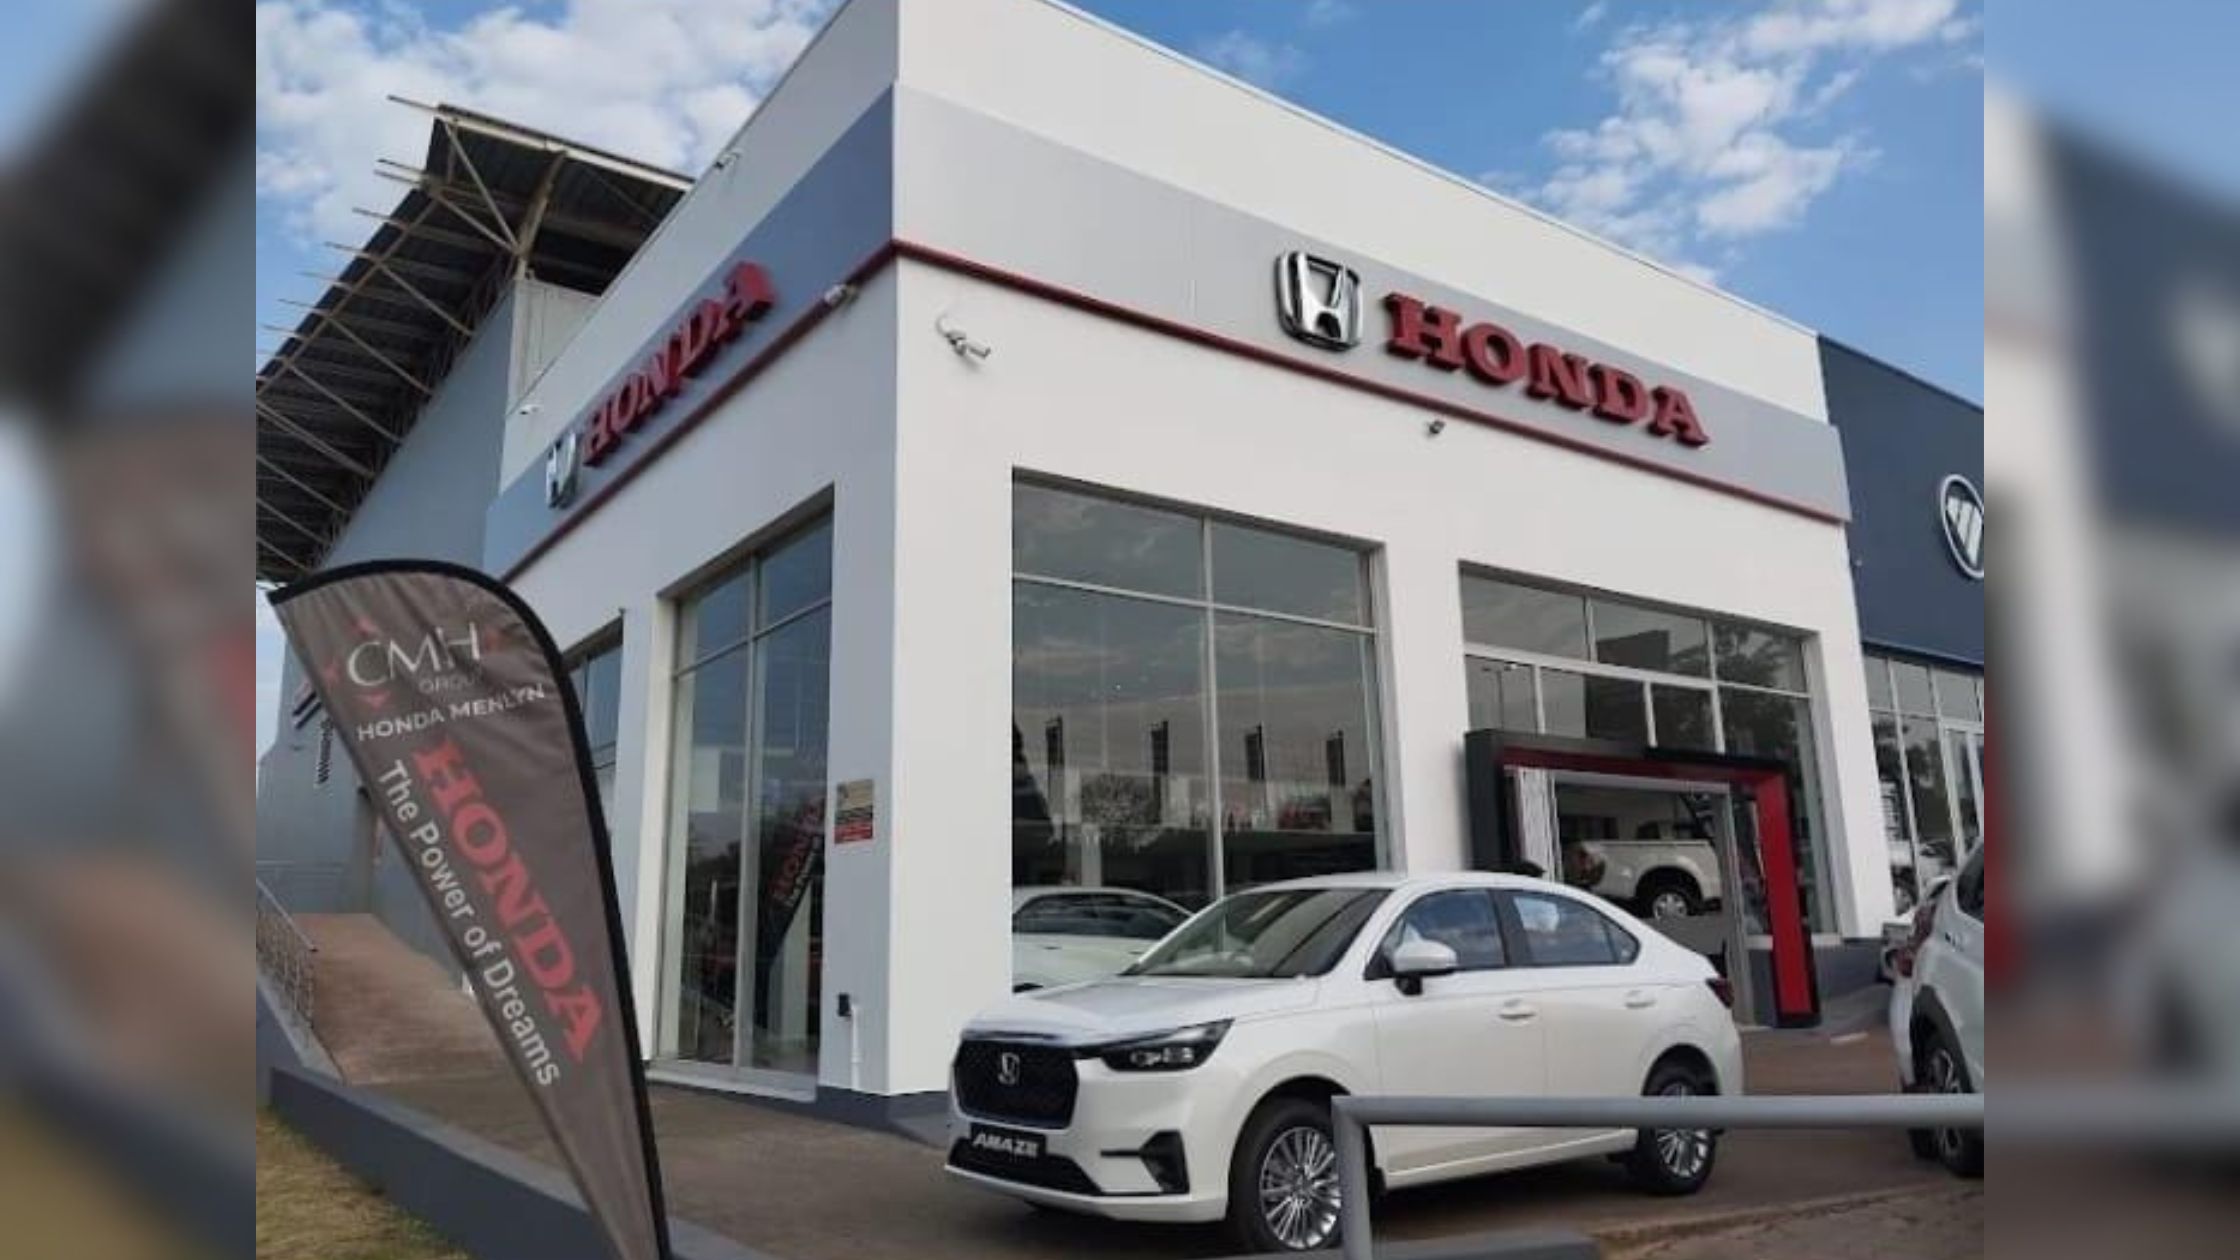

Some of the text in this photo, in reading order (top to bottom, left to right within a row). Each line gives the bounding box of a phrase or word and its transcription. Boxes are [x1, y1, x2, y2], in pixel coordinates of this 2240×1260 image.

[580, 260, 778, 467] HONDA
[1384, 292, 1709, 447] HONDA
[347, 621, 480, 686] CMH
[418, 673, 484, 694] GROU
[357, 682, 545, 741] HONDA MENLYN
[378, 759, 561, 1086] The Power of Dreams
[413, 740, 601, 1063] HONDA
[972, 1133, 1038, 1157] AMAZE
